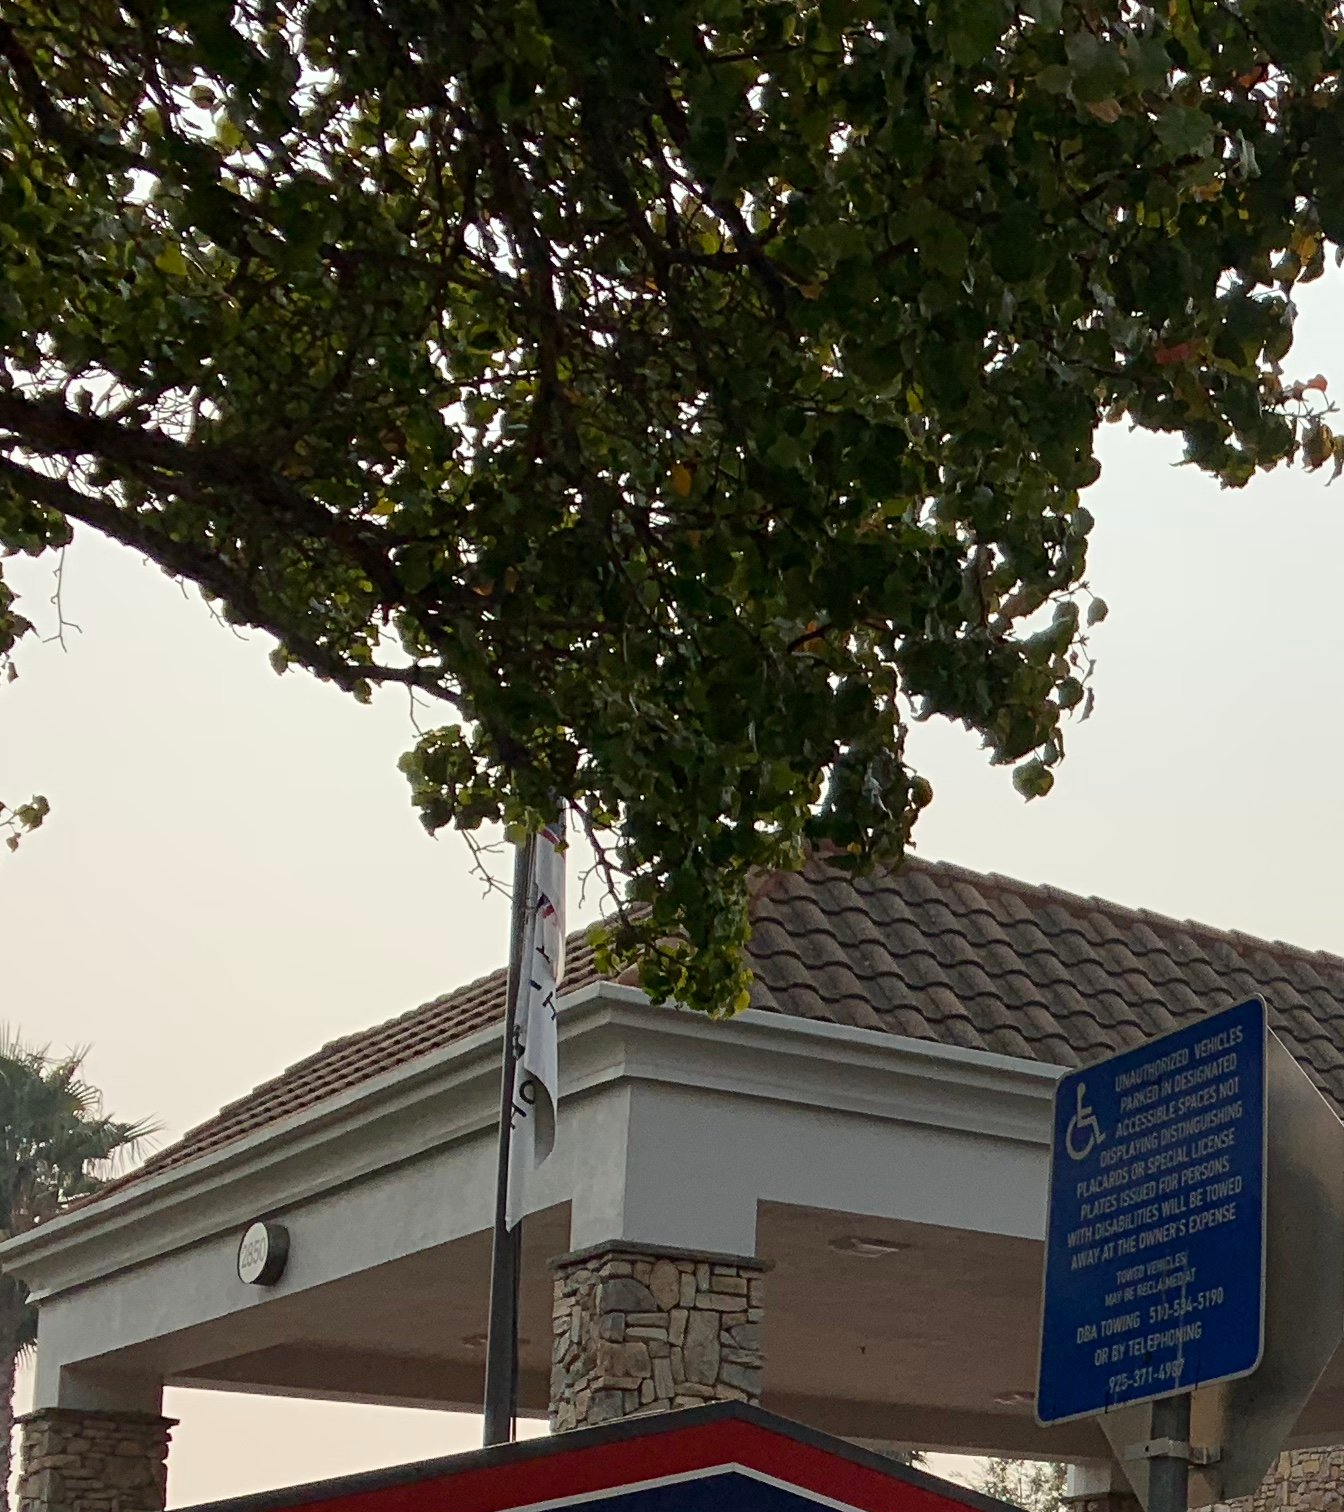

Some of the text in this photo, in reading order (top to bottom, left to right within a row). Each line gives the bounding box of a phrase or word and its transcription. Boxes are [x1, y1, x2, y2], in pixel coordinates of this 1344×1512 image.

[1115, 1025, 1243, 1092] UNAUTHORIZED VEHICLES
[1120, 1053, 1237, 1114] PARKED IN DESIGNATED
[1100, 1101, 1243, 1167] DISPLAYING DISTINGUISHING
[1116, 1077, 1239, 1139] ACCESSIBLE SPACES NOT
[1077, 1131, 1235, 1199] PLACARDS OR SPECIAL LICENSE
[1081, 1155, 1230, 1220] PLATES ISSUED FOR PERSONS
[1067, 1176, 1242, 1248] WITH DISABILITIES WILL BE TOWED
[1071, 1202, 1237, 1270] AWAY AT THE OWNER'S EXPENSE
[242, 1236, 266, 1268] 2850
[1116, 1253, 1187, 1285] TOWED VEHICLES
[1105, 1267, 1197, 1308] MAY BE RECLAIMED AT
[1077, 1324, 1097, 1344] DBA
[1101, 1311, 1141, 1337] TOWING
[1094, 1321, 1203, 1367] OR BY TELEPHONING
